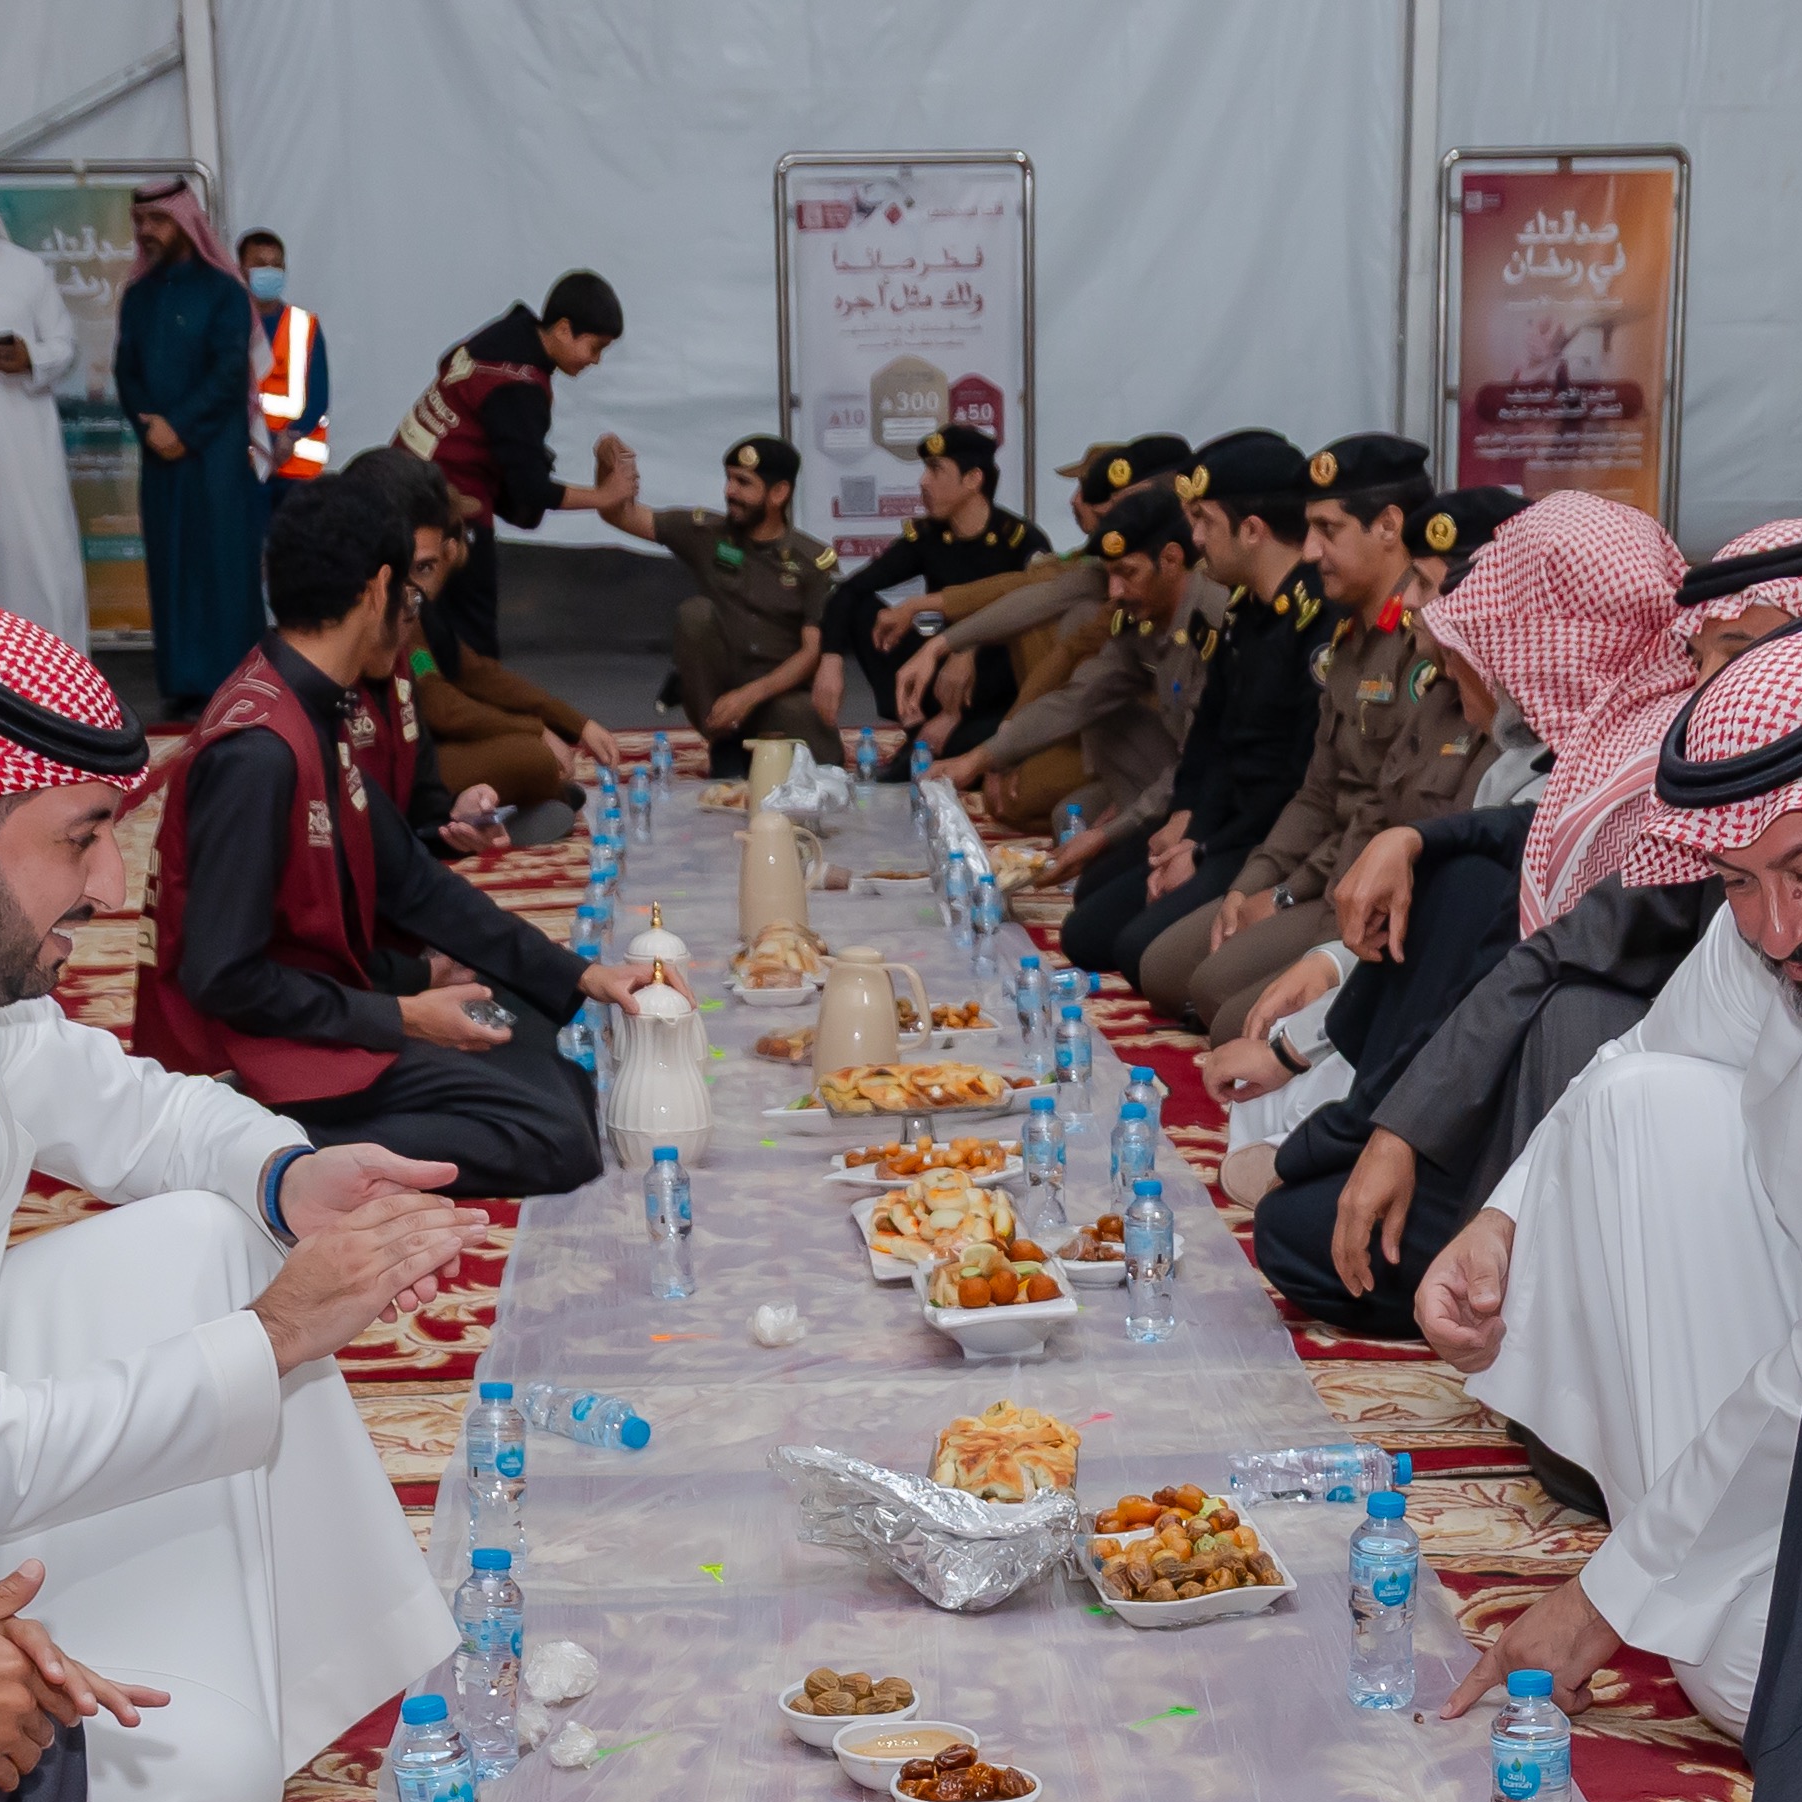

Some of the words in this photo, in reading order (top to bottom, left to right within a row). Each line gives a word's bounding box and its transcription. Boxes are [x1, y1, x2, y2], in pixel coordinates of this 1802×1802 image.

[1516, 209, 1619, 245] صدقتك
[1502, 244, 1584, 286] رمضان
[1587, 241, 1627, 297] في
[890, 282, 933, 313] مثل
[940, 281, 984, 316] ولك
[841, 407, 865, 425] 10
[896, 392, 940, 411] 300
[967, 403, 994, 420] 50
